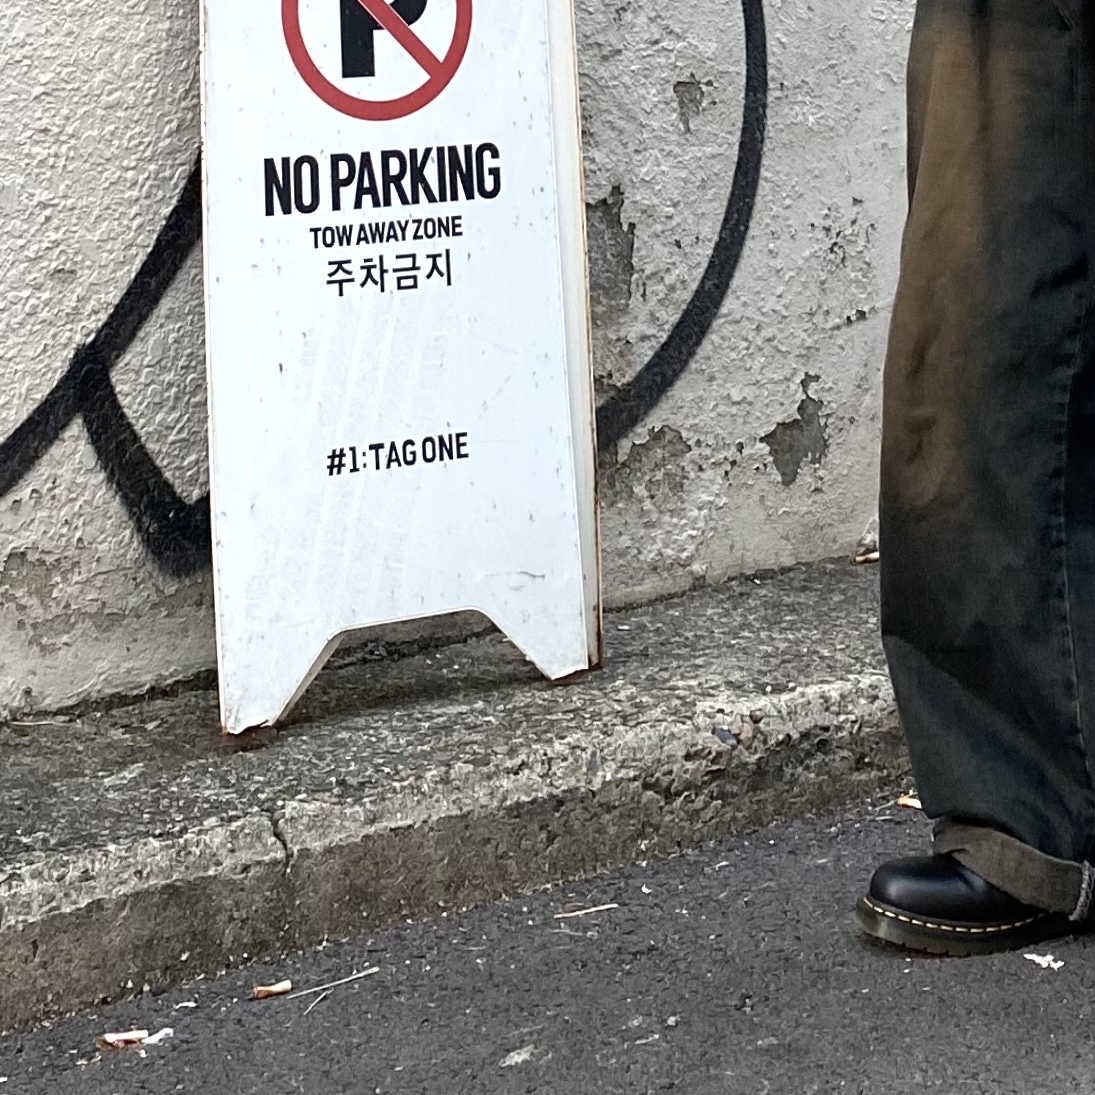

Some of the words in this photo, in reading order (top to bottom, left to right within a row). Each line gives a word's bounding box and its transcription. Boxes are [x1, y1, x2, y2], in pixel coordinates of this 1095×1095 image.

[263, 154, 320, 217] NO
[330, 142, 501, 212] PARKING
[309, 224, 354, 249] TOW
[356, 219, 410, 246] AWAY
[411, 215, 463, 241] ZONE
[326, 248, 452, 297] 주차금지
[326, 439, 417, 476] #1:TAG
[421, 431, 469, 464] ONE
